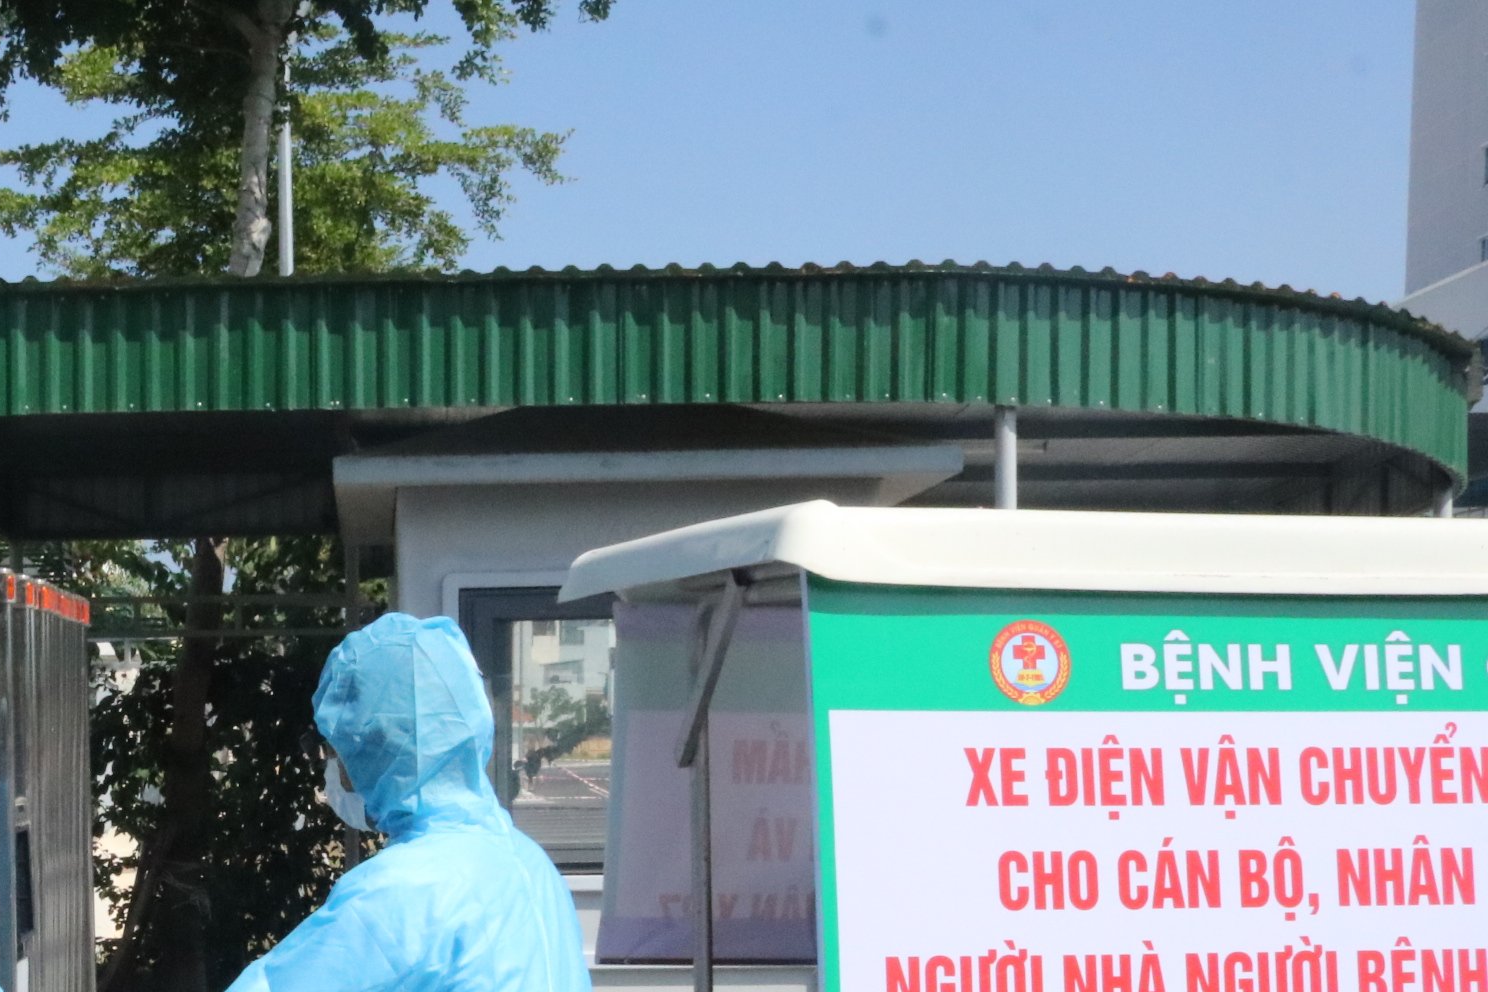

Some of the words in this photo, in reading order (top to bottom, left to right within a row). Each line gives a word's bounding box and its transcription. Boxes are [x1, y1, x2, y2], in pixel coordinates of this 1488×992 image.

[1121, 630, 1291, 704] BỆNH
[1315, 631, 1462, 704] VIỆN
[965, 748, 1028, 806] XE
[1046, 735, 1164, 820] ĐIỆN
[1181, 735, 1281, 819] VẬN
[999, 850, 1099, 911] CHO
[1118, 837, 1221, 910] CÁN
[1239, 836, 1319, 921] BỘ,
[1337, 835, 1475, 906] NHÂN
